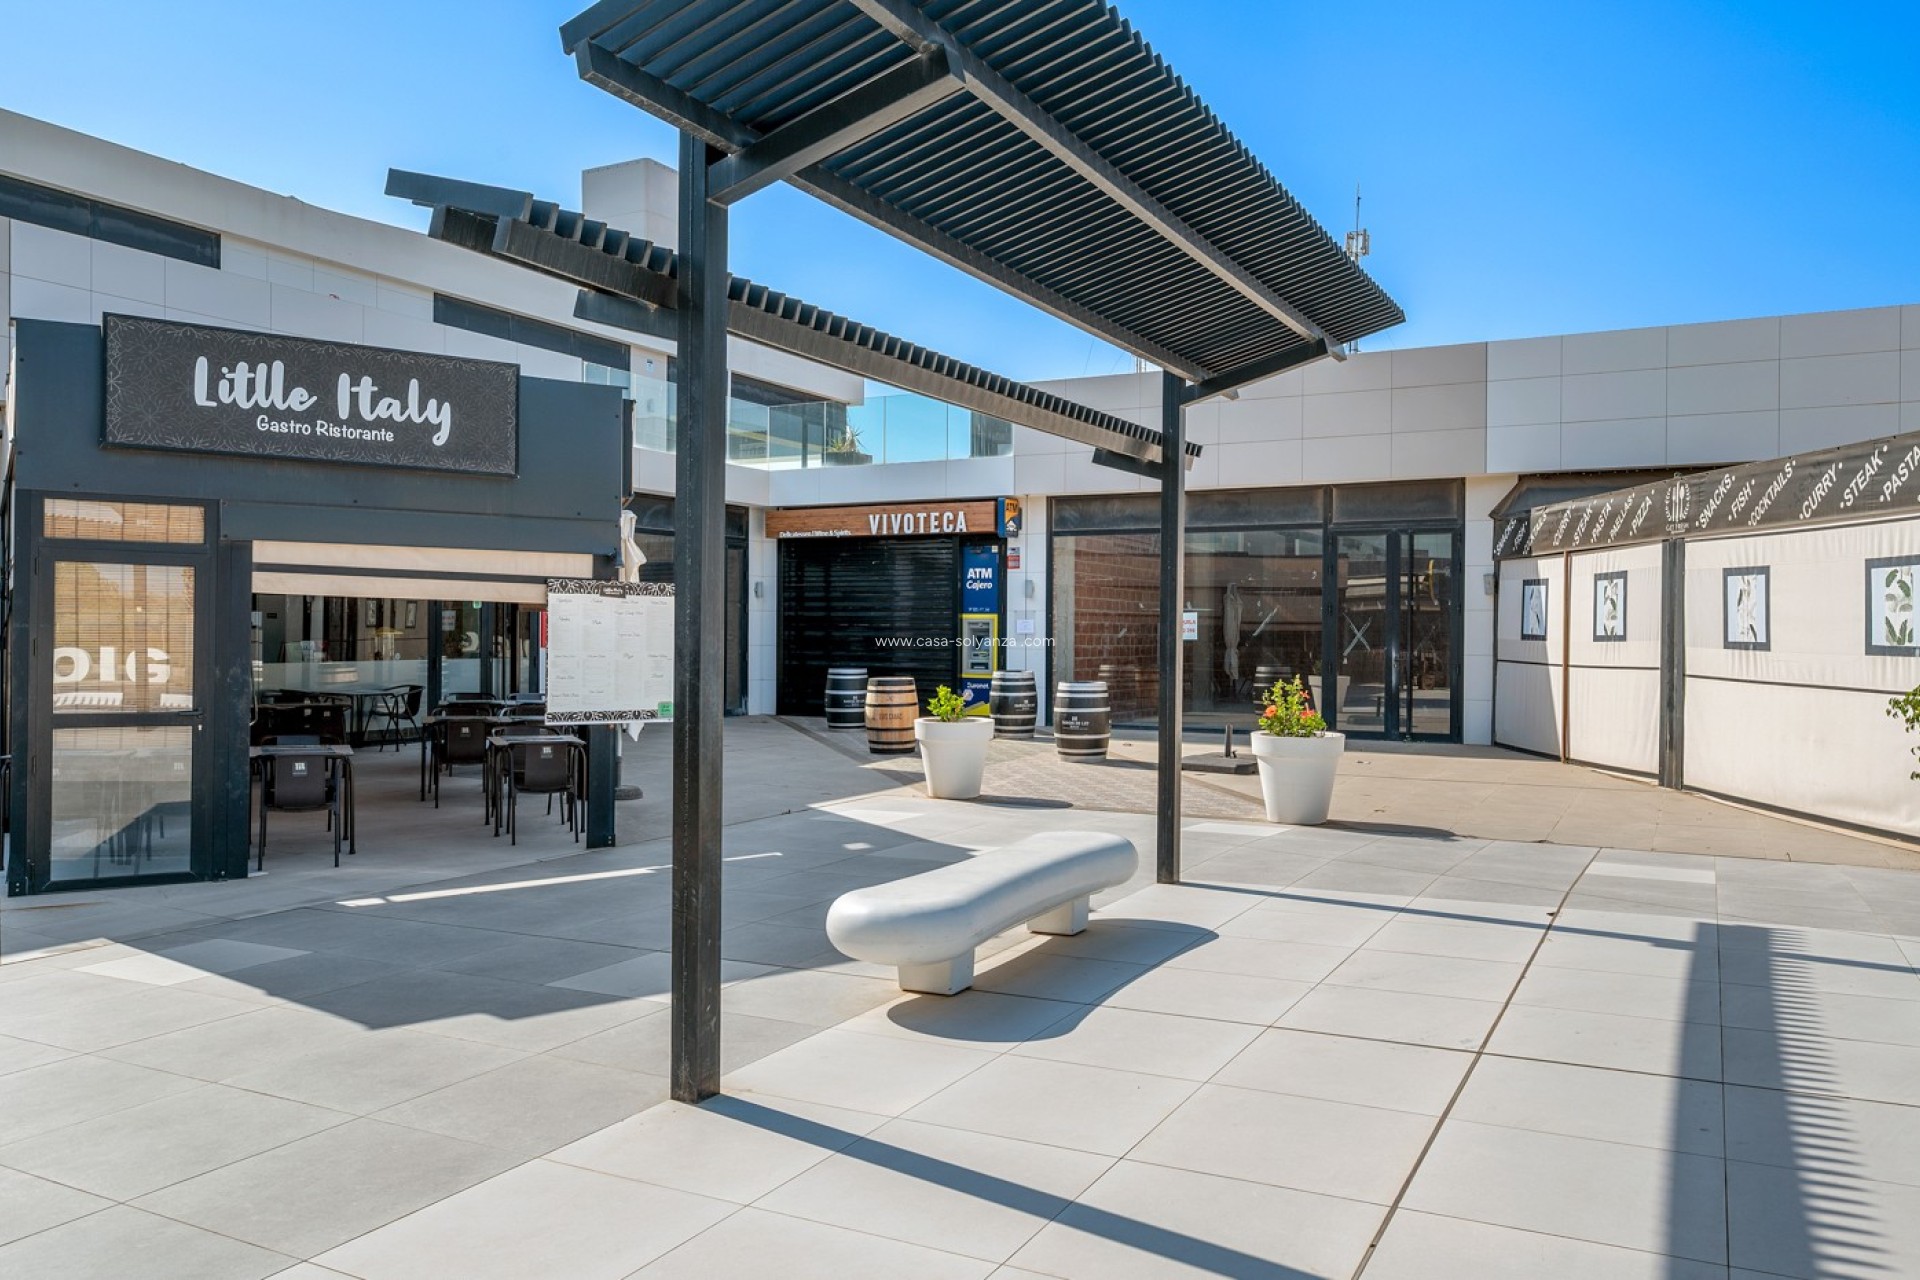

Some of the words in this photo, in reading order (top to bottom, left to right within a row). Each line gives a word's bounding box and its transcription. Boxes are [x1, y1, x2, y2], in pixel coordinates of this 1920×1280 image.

[337, 373, 451, 447] Italy
[256, 414, 311, 435] Gastro
[316, 420, 395, 442] Ristorante
[1699, 473, 1733, 529] SNACKS
[1731, 481, 1752, 519] FISH
[1750, 461, 1793, 526] COCKTAILS
[1801, 463, 1838, 519] CURRY
[1843, 449, 1884, 507] STEAK
[1882, 445, 1920, 502] PASTA
[868, 511, 968, 535] VIVOTECA
[1554, 506, 1572, 546] CURRY
[1573, 504, 1593, 545] STEAK
[1592, 503, 1612, 542] PASTA
[1610, 496, 1633, 540] PAELLAS
[1632, 495, 1653, 534] PIZZA
[966, 580, 992, 591] Cajero
[967, 568, 992, 579] ATM
